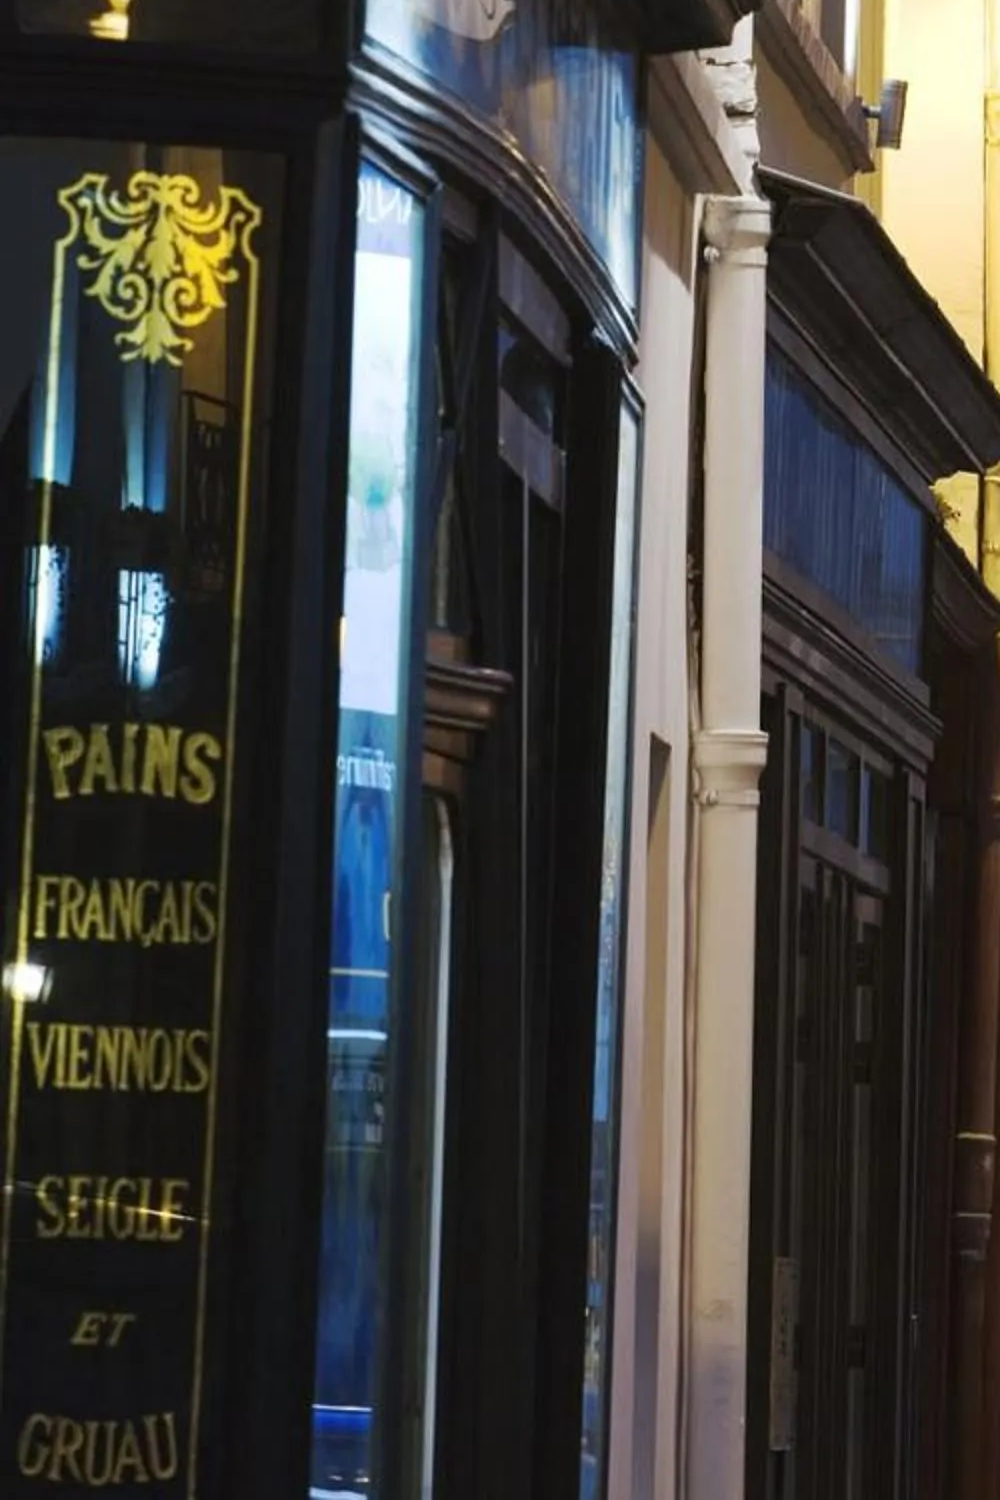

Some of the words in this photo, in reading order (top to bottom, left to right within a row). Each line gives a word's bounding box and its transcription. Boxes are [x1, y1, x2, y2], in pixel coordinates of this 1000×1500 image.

[42, 722, 221, 804] PAINS
[33, 874, 217, 948] FRANÇAIS
[26, 1022, 211, 1093] VIENNOIS
[35, 1174, 191, 1242] SEIGLE
[71, 1311, 135, 1347] ET
[18, 1412, 179, 1487] GRUAU
